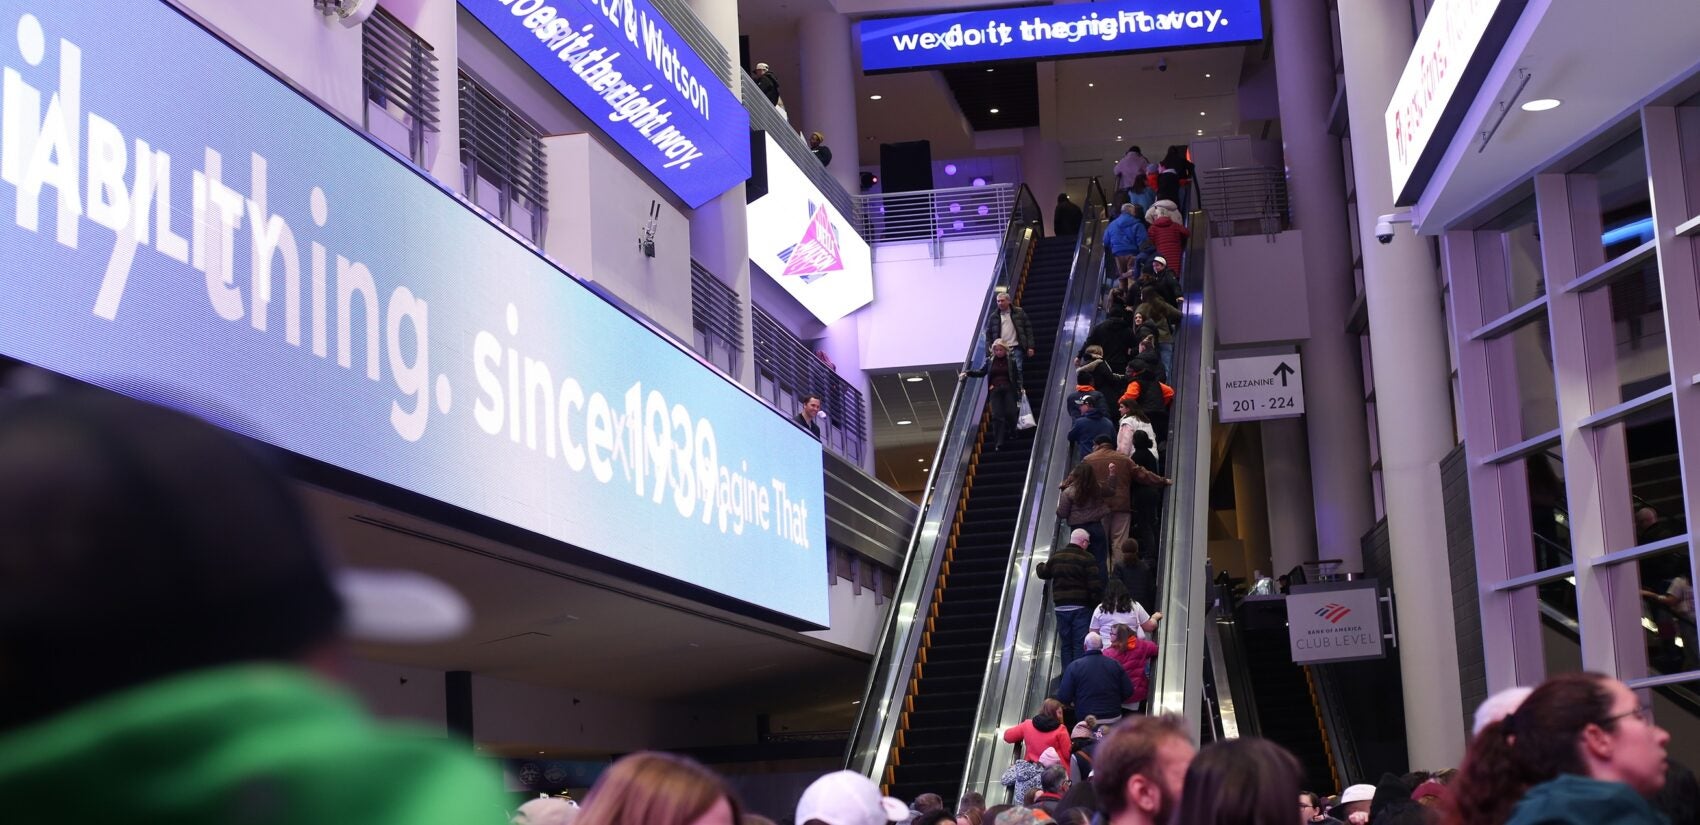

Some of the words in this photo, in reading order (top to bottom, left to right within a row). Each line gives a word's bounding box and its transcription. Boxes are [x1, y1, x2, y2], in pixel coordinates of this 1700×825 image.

[641, 10, 709, 120] Watson
[651, 125, 704, 169] way.
[473, 302, 613, 484] since
[1225, 378, 1275, 389] MEZZANINE
[1232, 399, 1256, 412] 201
[1268, 396, 1295, 409] 224
[772, 477, 809, 548] That
[1296, 637, 1331, 650] CLUB
[1335, 633, 1376, 647] LEVEL
